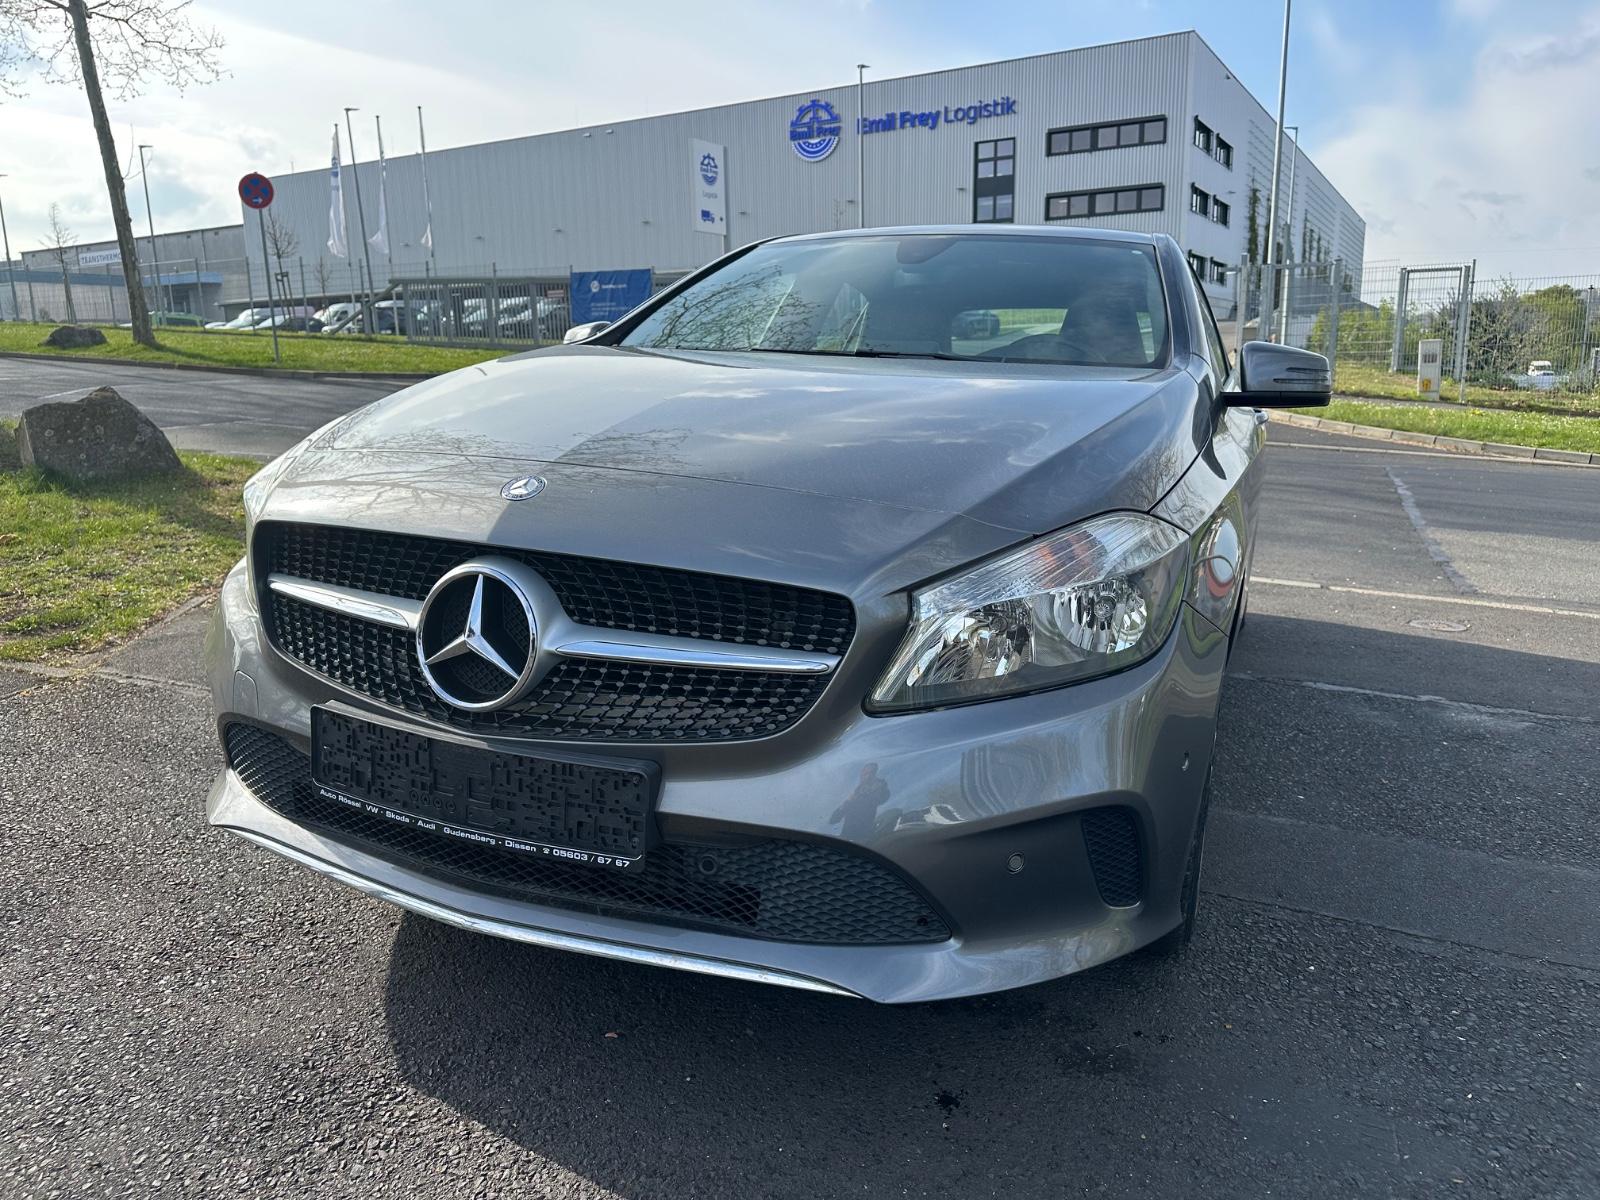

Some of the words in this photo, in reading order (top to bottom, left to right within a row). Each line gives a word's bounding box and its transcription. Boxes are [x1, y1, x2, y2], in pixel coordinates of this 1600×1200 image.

[857, 112, 896, 135] Emil
[899, 109, 941, 130] Frey
[943, 96, 1017, 125] Logistik
[320, 788, 337, 800] Auto
[365, 804, 379, 814] VW
[385, 811, 410, 823] Skoda
[417, 820, 436, 830] Audi
[443, 827, 496, 845] Gudensberg
[504, 839, 537, 852] Dissen
[552, 848, 588, 861] 05603
